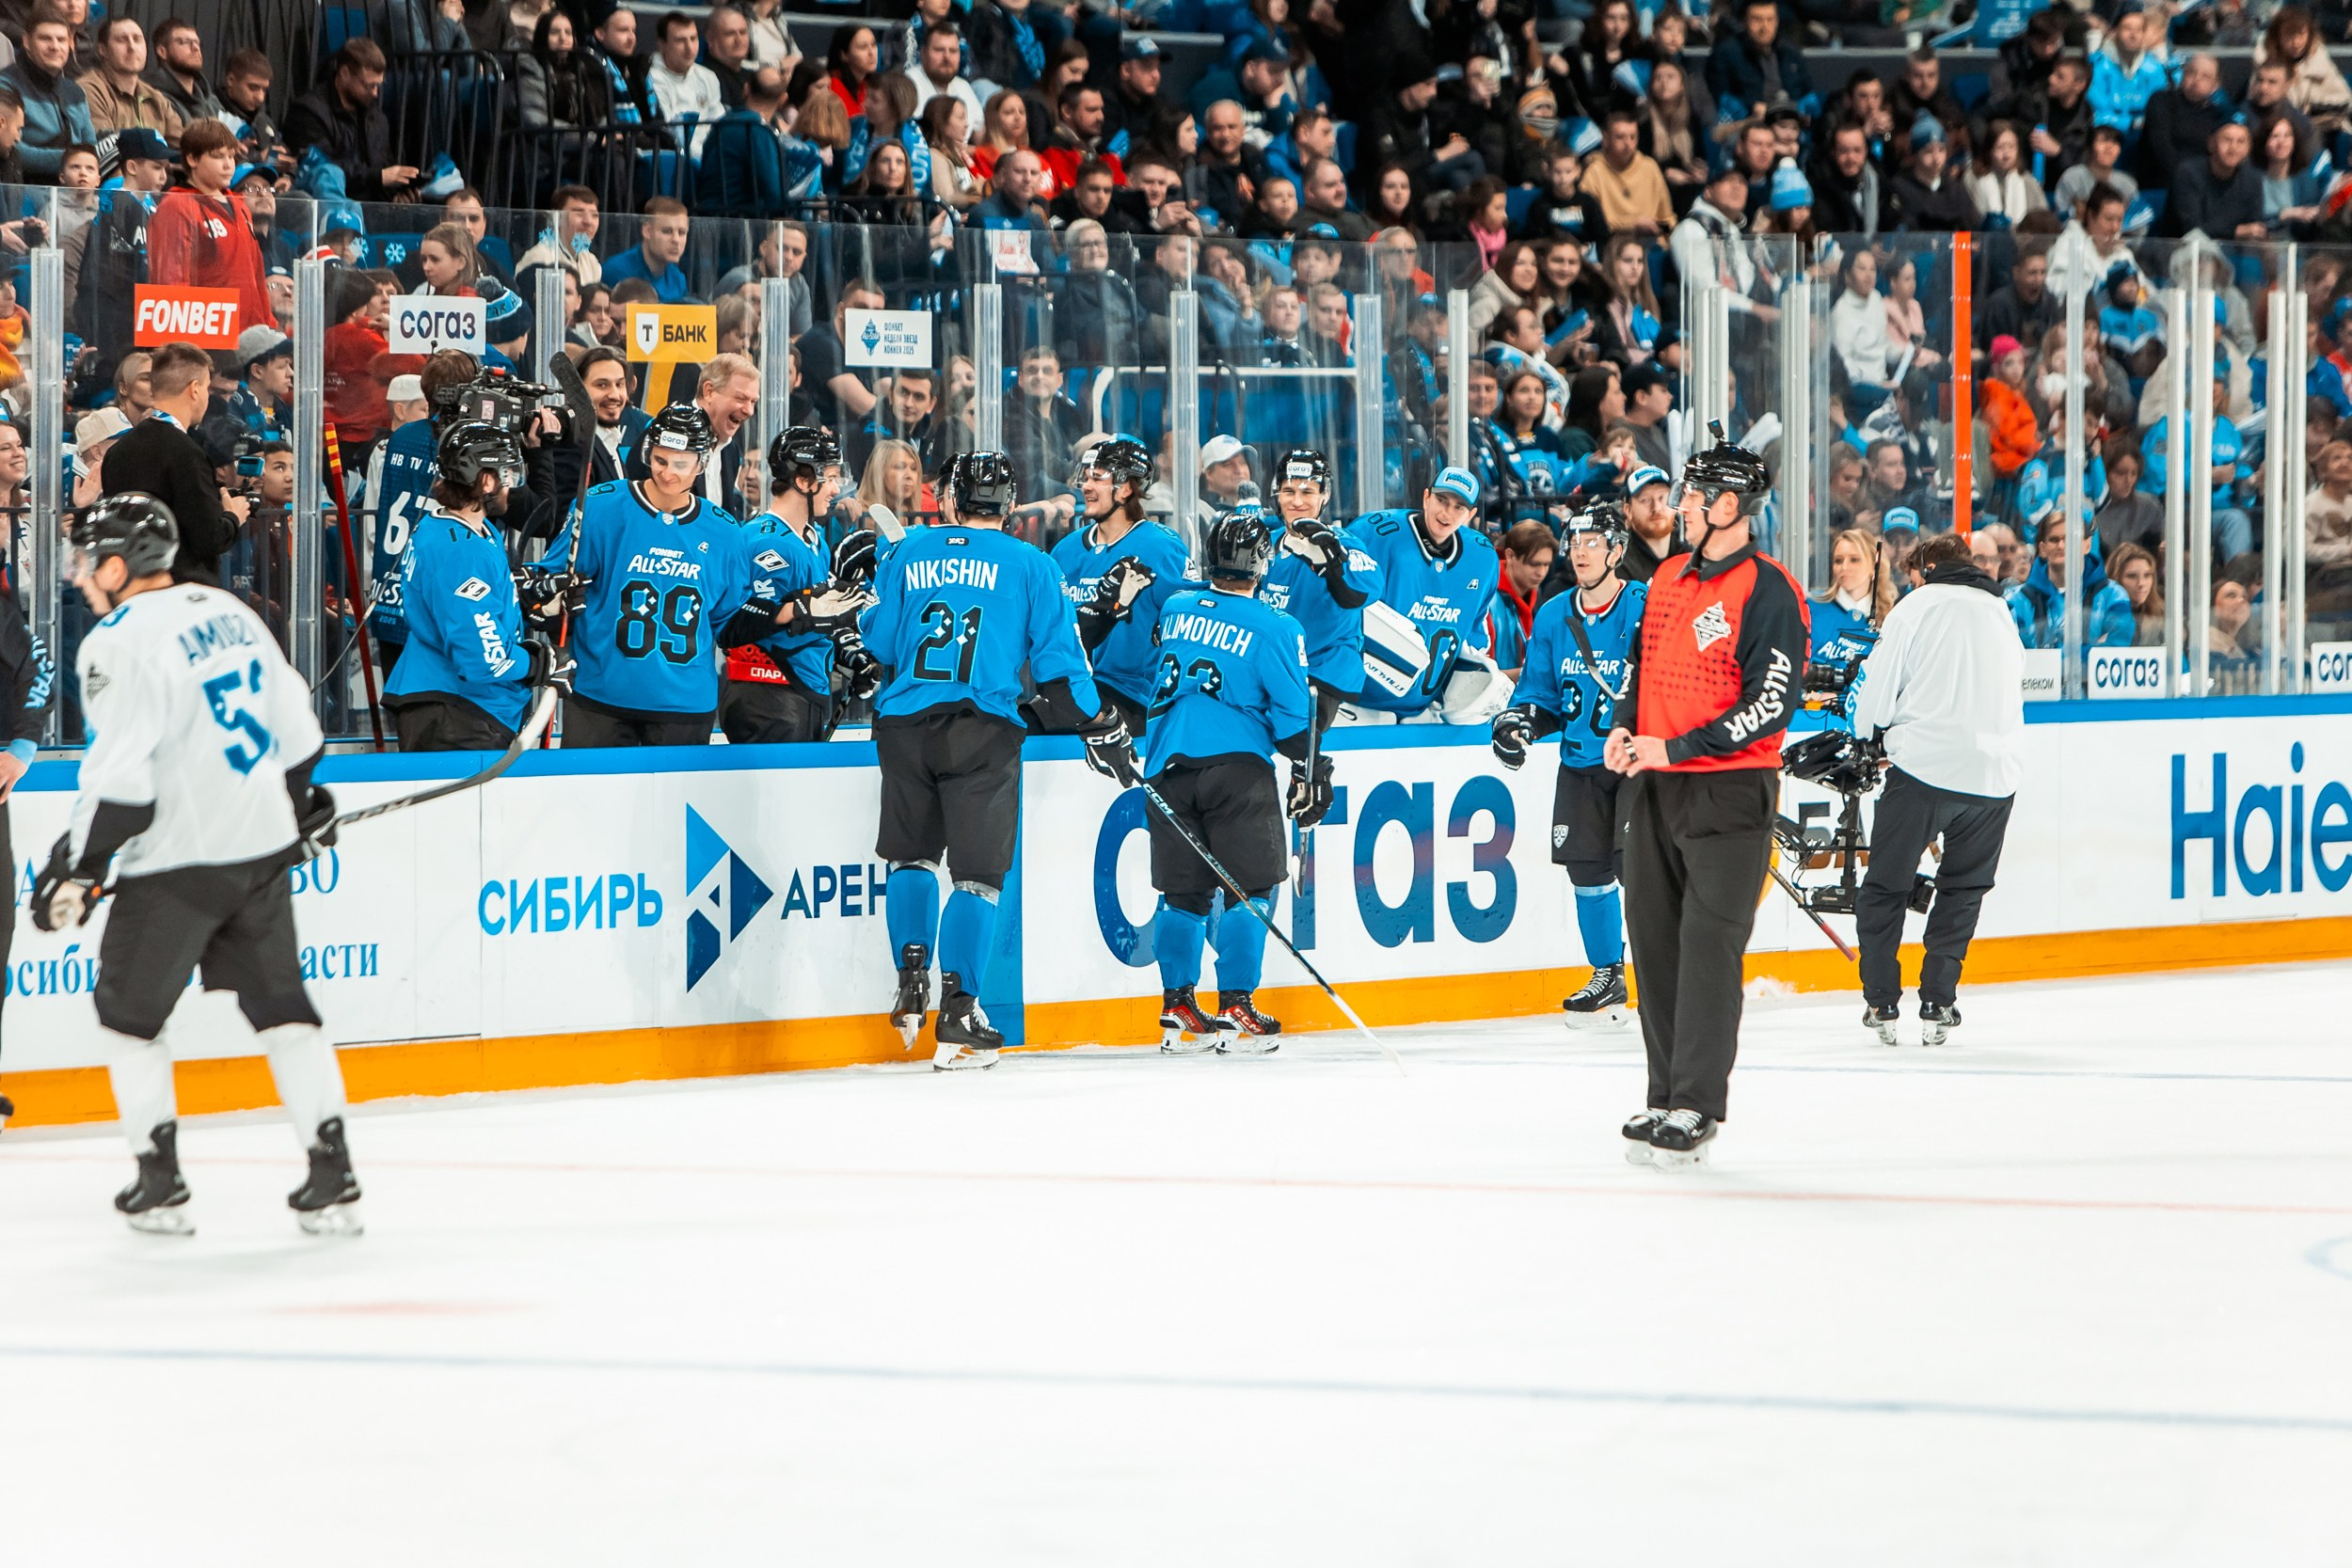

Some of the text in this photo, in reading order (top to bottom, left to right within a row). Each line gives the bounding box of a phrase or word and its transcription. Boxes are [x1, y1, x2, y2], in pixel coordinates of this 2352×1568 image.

[136, 299, 237, 336] FONBET
[400, 309, 476, 341] согаз
[663, 324, 707, 342] БАНК
[883, 334, 918, 344] НЕДЕЛЯ ЗВЕЗД
[649, 546, 685, 559] FONBET
[905, 558, 999, 592] NIKISHIN
[615, 578, 706, 667] 89
[912, 600, 984, 687] 21
[2021, 677, 2055, 690] елеком
[2095, 657, 2160, 688] согаз
[2318, 653, 2352, 682] сог
[1142, 783, 1175, 815] CCM
[2169, 740, 2352, 900] Haie
[1093, 774, 1518, 968] сгаз
[477, 872, 663, 936] СИБИРЬ
[780, 863, 891, 920] АРЕН
[1232, 1007, 1262, 1034] CCM
